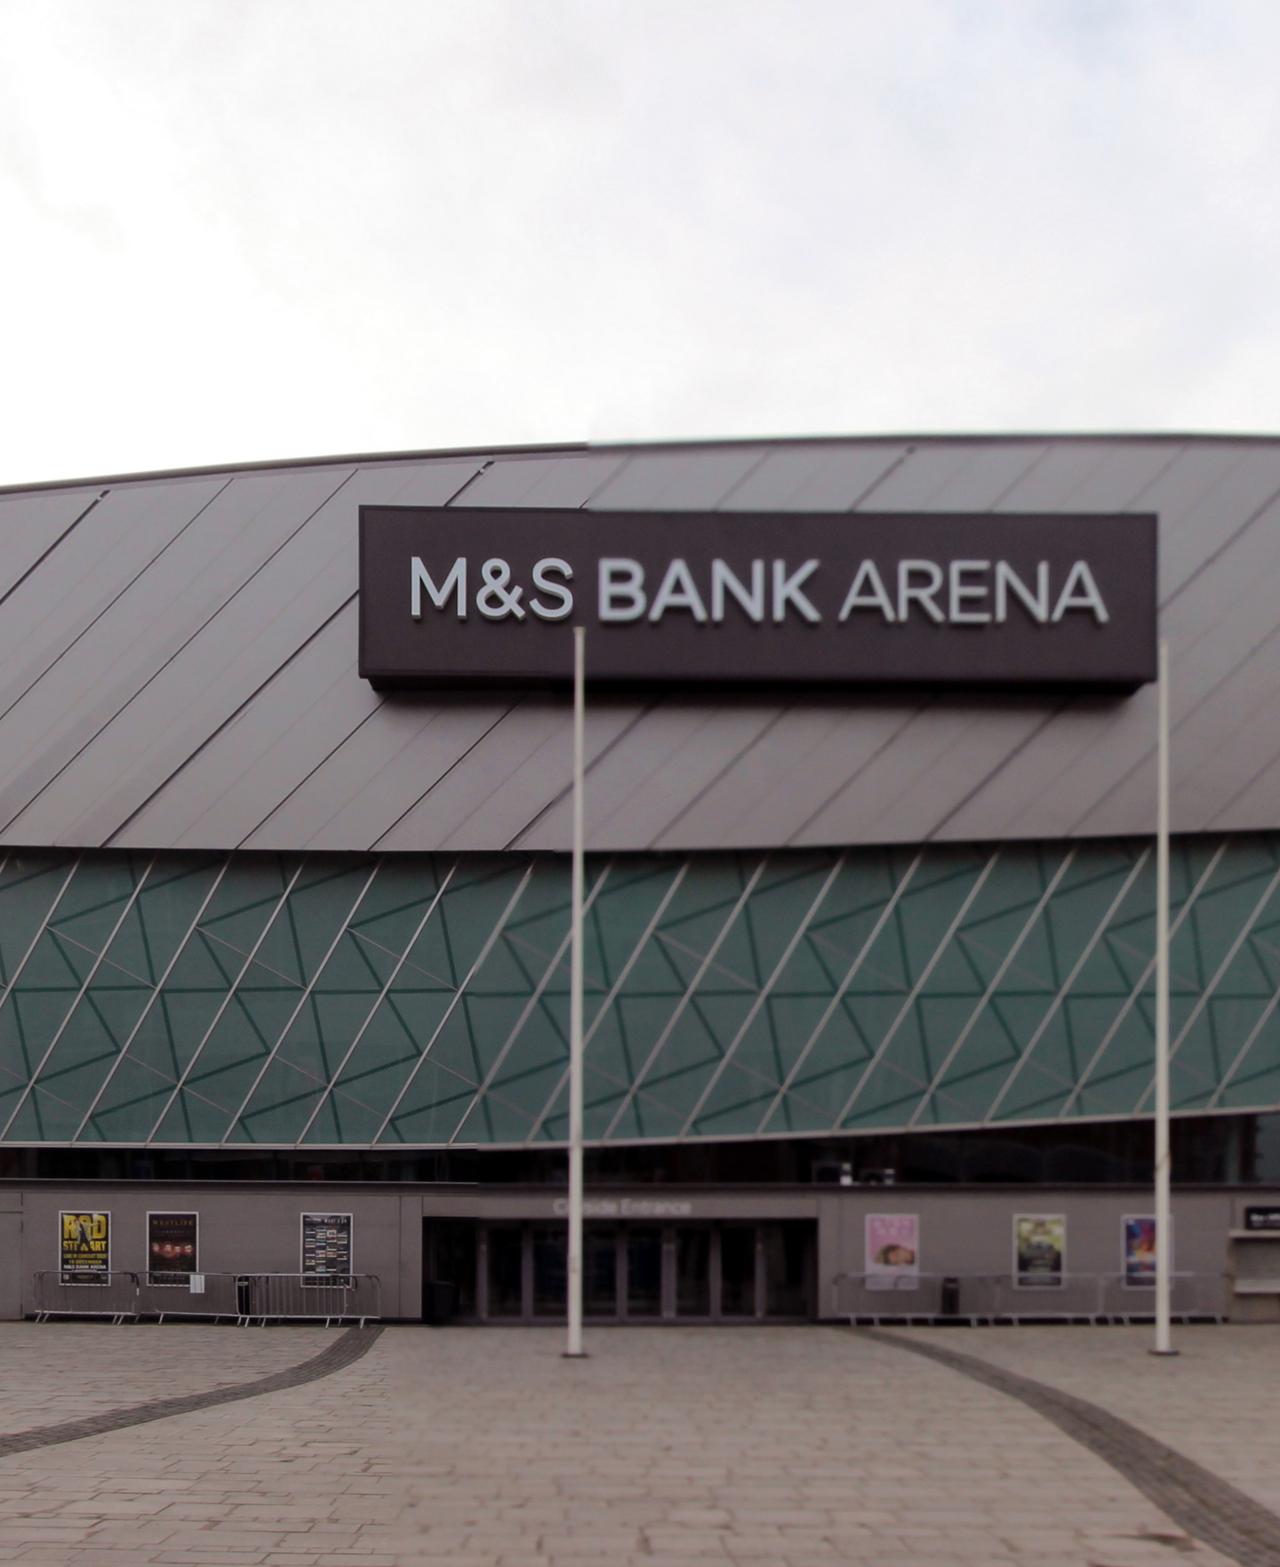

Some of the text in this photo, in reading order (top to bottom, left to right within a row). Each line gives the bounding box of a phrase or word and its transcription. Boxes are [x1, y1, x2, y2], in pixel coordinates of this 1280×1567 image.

[411, 556, 1110, 624] M&S BANK ARENA
[552, 1198, 691, 1217] Ciside Entrance
[63, 1215, 107, 1239] ROD
